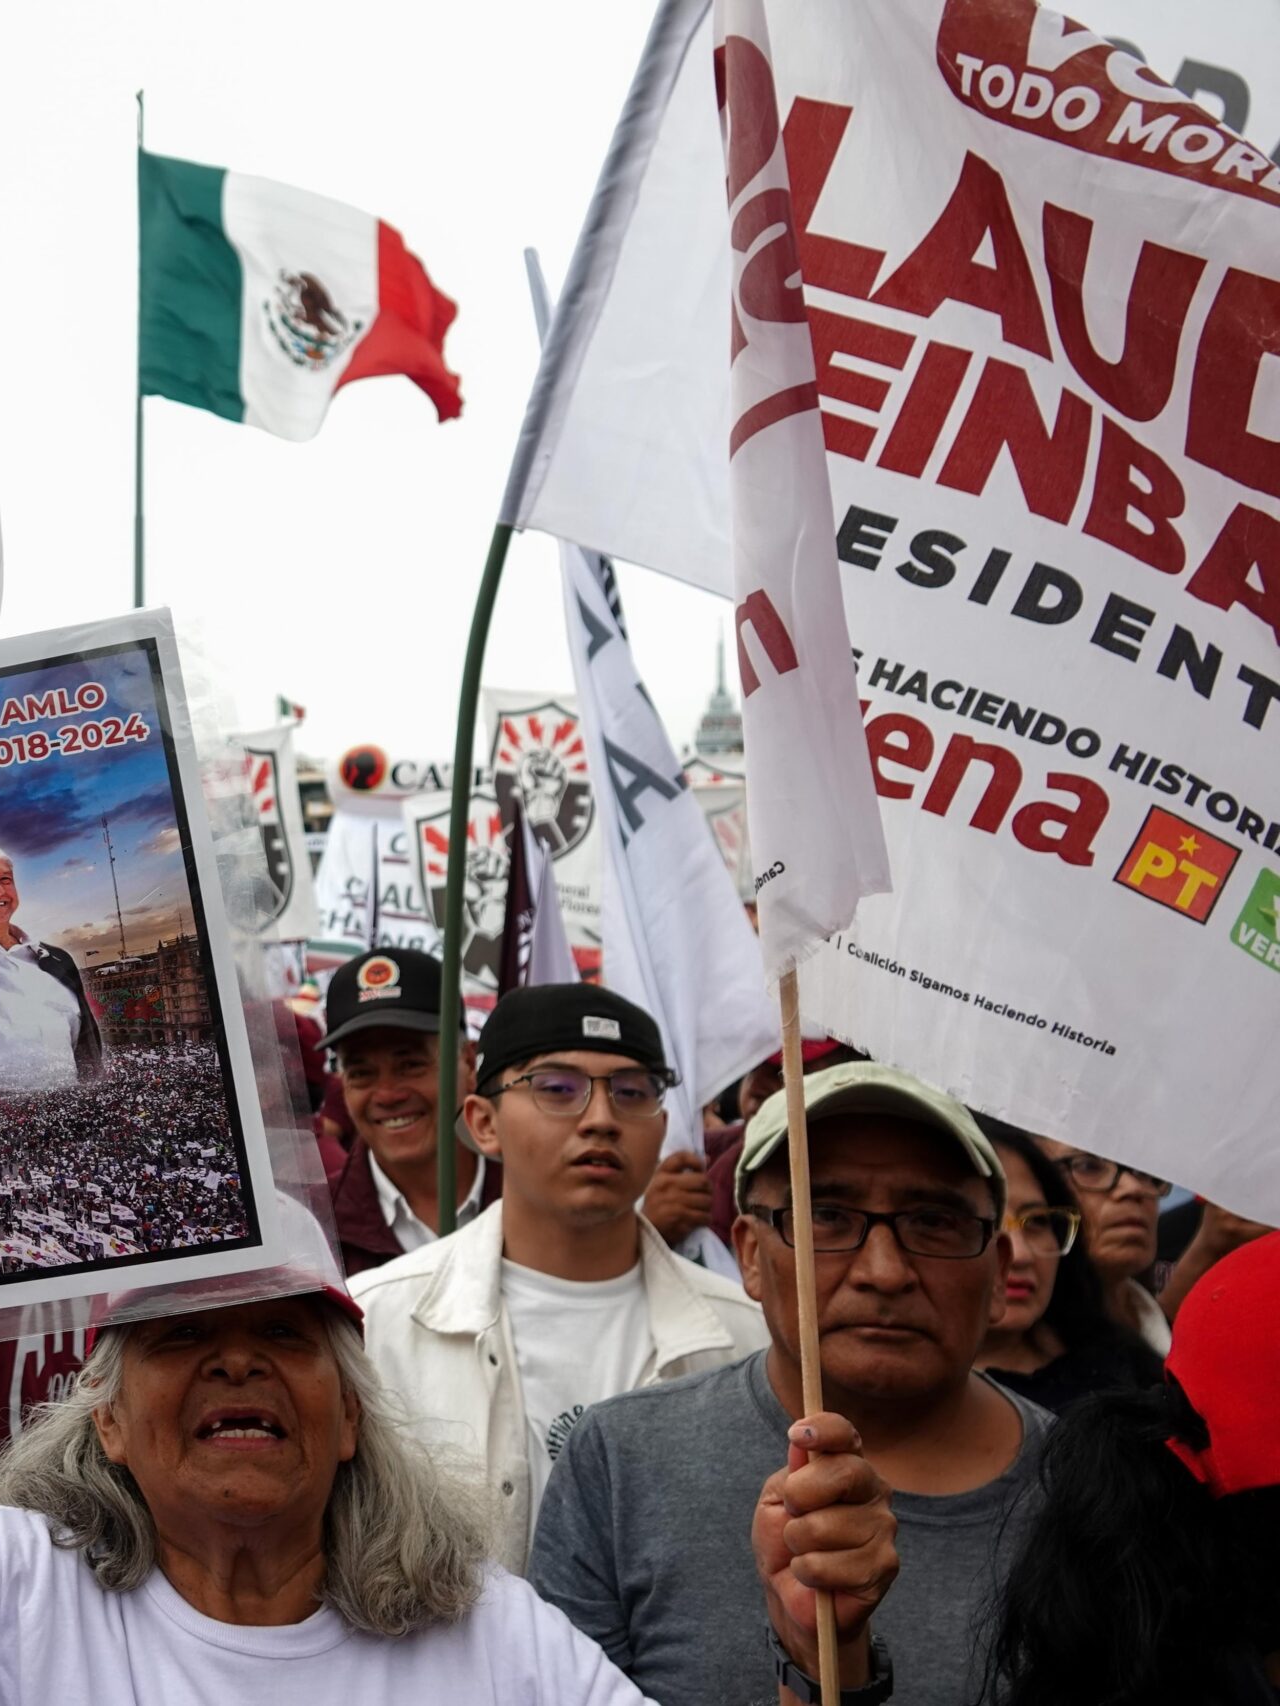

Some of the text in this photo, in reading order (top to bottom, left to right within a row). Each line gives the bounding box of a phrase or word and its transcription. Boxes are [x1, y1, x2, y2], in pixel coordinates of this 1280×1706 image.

[955, 52, 1102, 132] TODO
[835, 504, 1280, 731] ESIDENT
[0, 683, 106, 728] AMLO
[867, 657, 1280, 858] HACIENDO HISTORI
[859, 699, 1219, 910] ena PT
[846, 942, 906, 978] Coalición
[909, 970, 970, 1003] Sigamos
[973, 994, 1048, 1030] Haciendo
[1050, 1022, 1117, 1058] Historia
